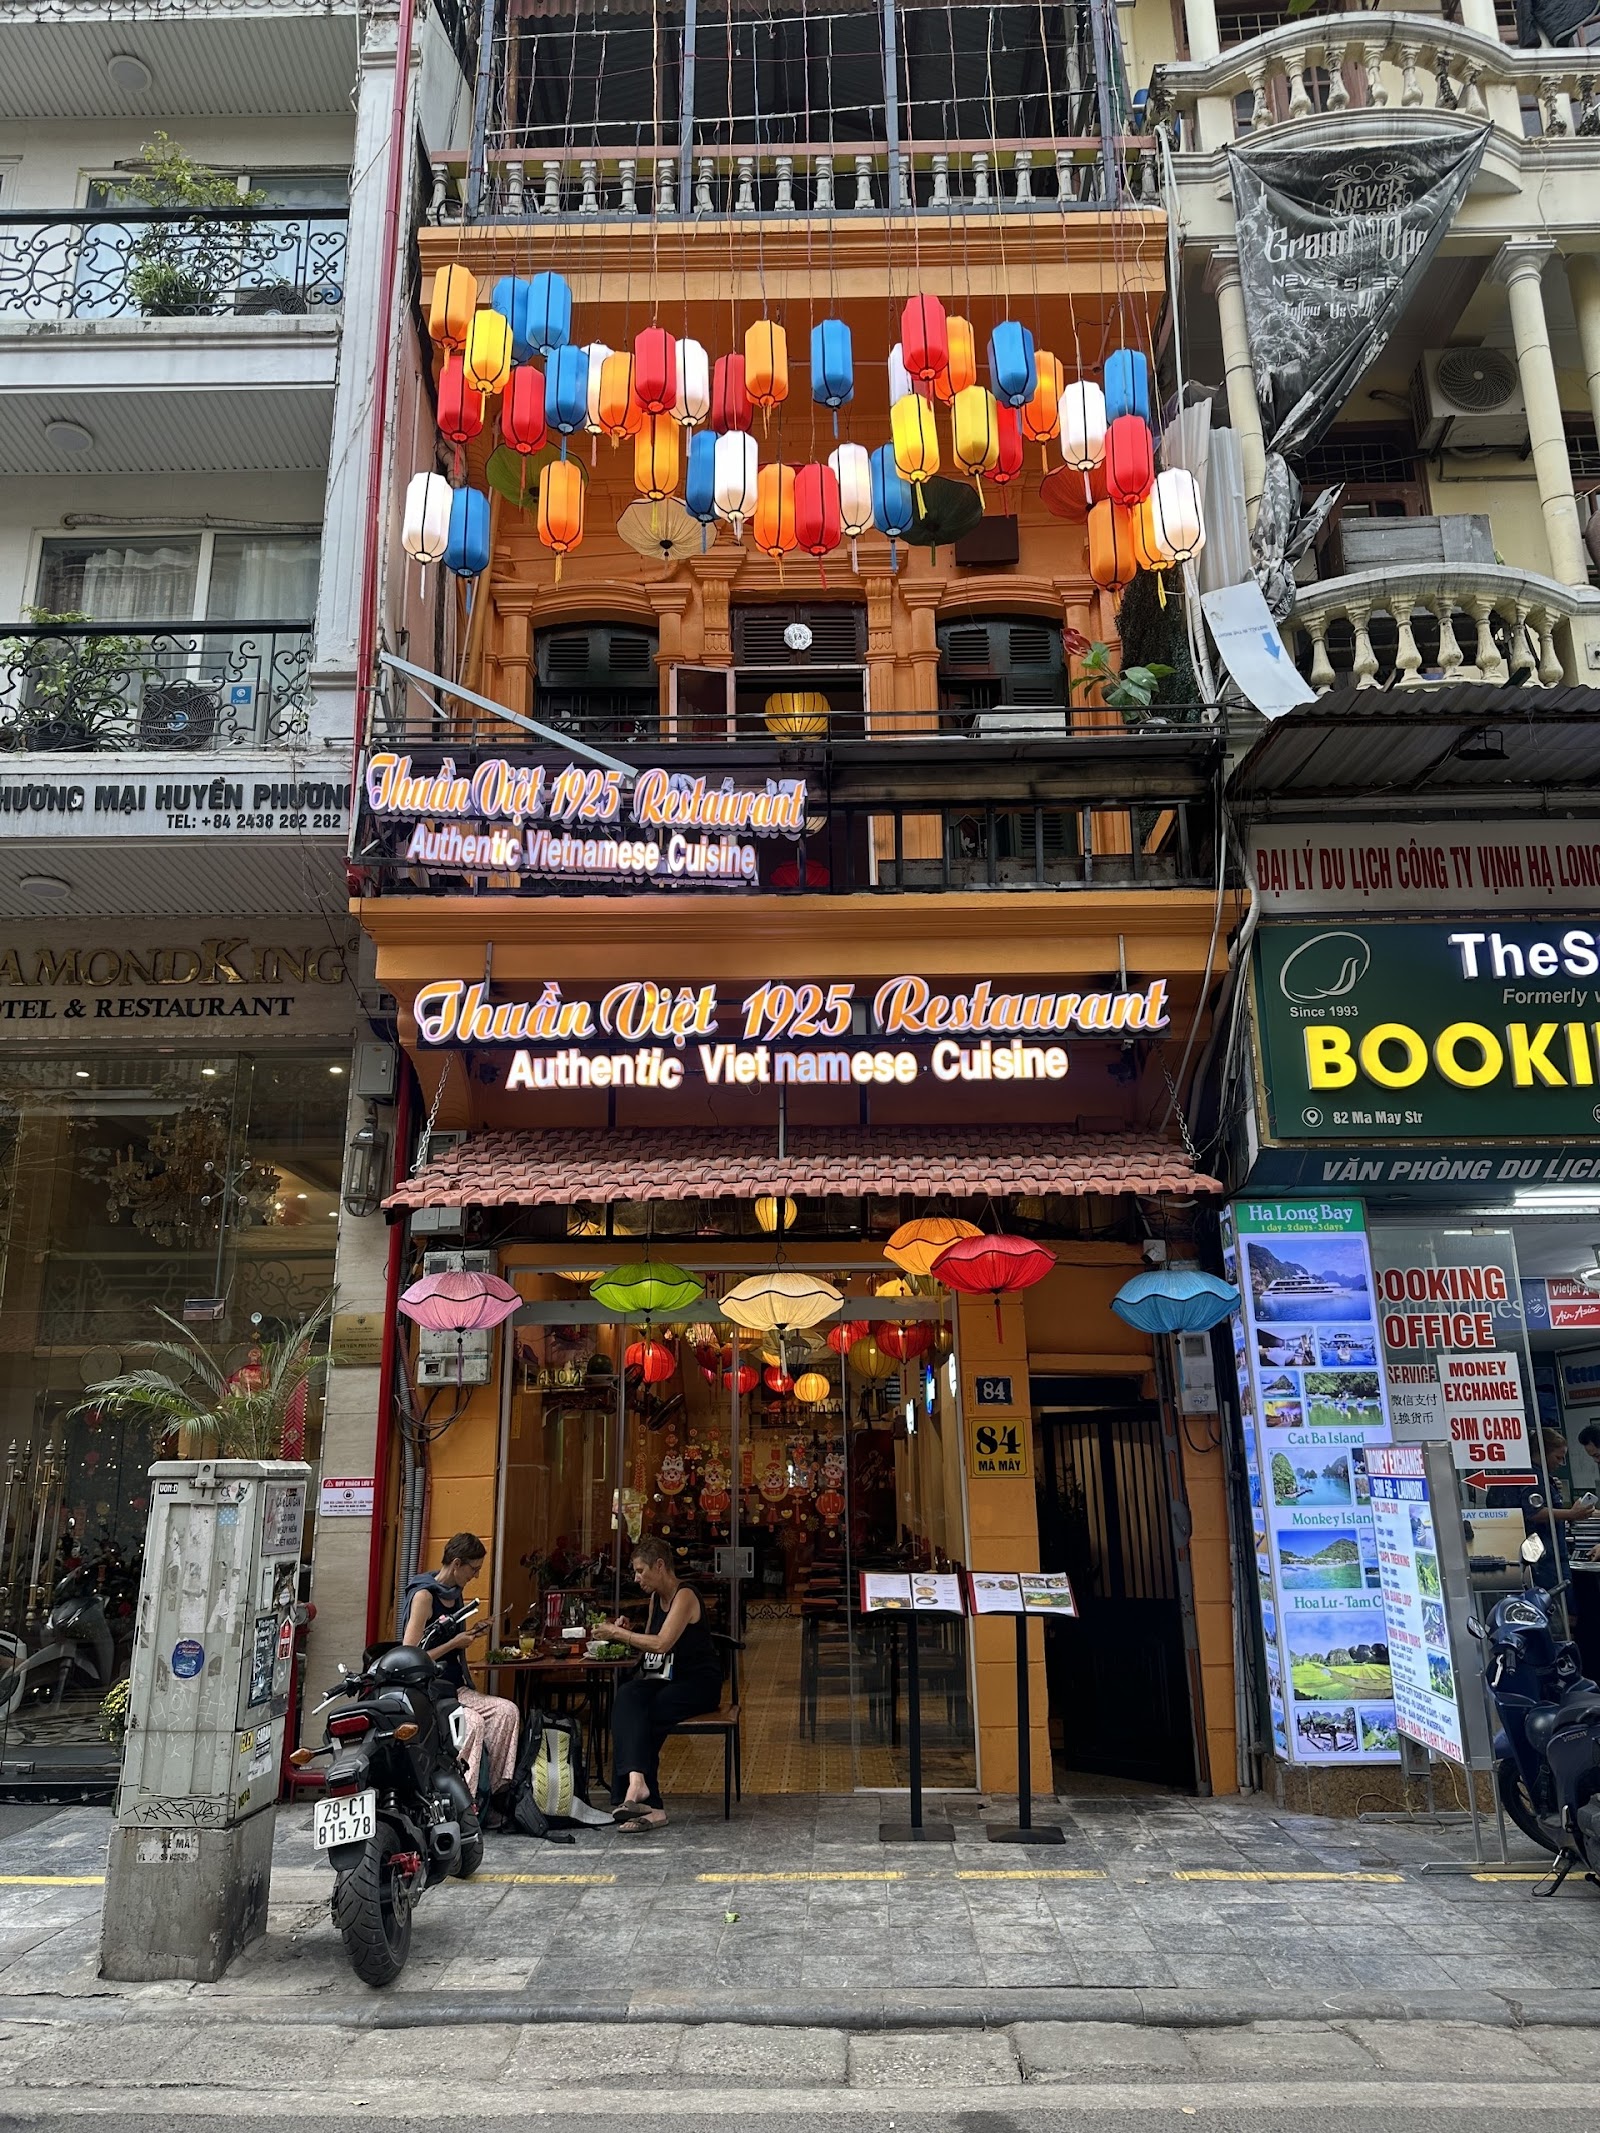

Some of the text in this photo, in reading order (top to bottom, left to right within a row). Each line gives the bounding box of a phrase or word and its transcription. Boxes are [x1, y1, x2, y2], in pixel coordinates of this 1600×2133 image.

[1264, 219, 1354, 263] Grand
[95, 785, 147, 815] MẠI
[155, 777, 243, 812] HUYỀN
[550, 762, 624, 822] 1925
[632, 767, 808, 831] Restaurant
[166, 813, 341, 829] TEL: +84 2438 282 282
[407, 822, 757, 879] Authentic Vietnamese Cuisine
[1257, 848, 1289, 898] ĐẠI
[1293, 839, 1313, 890] LÝ
[1318, 848, 1346, 890] DU
[1349, 847, 1393, 897] LỊCH
[1395, 837, 1449, 890] CÔNG
[1450, 846, 1474, 889] TY
[1477, 845, 1523, 896] VỊNH
[1525, 844, 1555, 895] HẠ
[1502, 986, 1588, 1007] Formerly
[0, 996, 295, 1020] TEL & RESTAURANT
[413, 974, 1171, 1050] Thuần Việt 1925 Restaurant
[1290, 1005, 1359, 1018] Since 1993
[505, 1039, 1069, 1091] Authentic Vietnamese Cuisine
[1333, 1110, 1423, 1128] 82 Ma May Str
[1322, 1157, 1384, 1182] VĂN
[1388, 1156, 1493, 1181] PHÒNG
[1497, 1158, 1544, 1180] DU
[1248, 1204, 1354, 1225] Ha Long Bay
[1266, 1224, 1282, 1233] day
[1384, 1312, 1497, 1349] OFFICE
[1448, 1361, 1507, 1377] MONEY
[983, 1381, 1006, 1400] 84
[1444, 1381, 1518, 1402] EXCHANGE
[1288, 1432, 1365, 1444] Cat Ba Island
[1450, 1417, 1522, 1441] SIM CARD
[976, 1426, 1022, 1455] 84
[1469, 1443, 1506, 1462] 5G
[978, 1458, 1021, 1471] MÃ MÂY
[1292, 1513, 1340, 1528] Monkey
[1479, 1511, 1509, 1519] CRUISE
[1294, 1597, 1319, 1609] Hoa
[1345, 1596, 1371, 1608] Tam
[324, 1796, 366, 1823] 29-C1
[319, 1816, 372, 1846] 815.78
